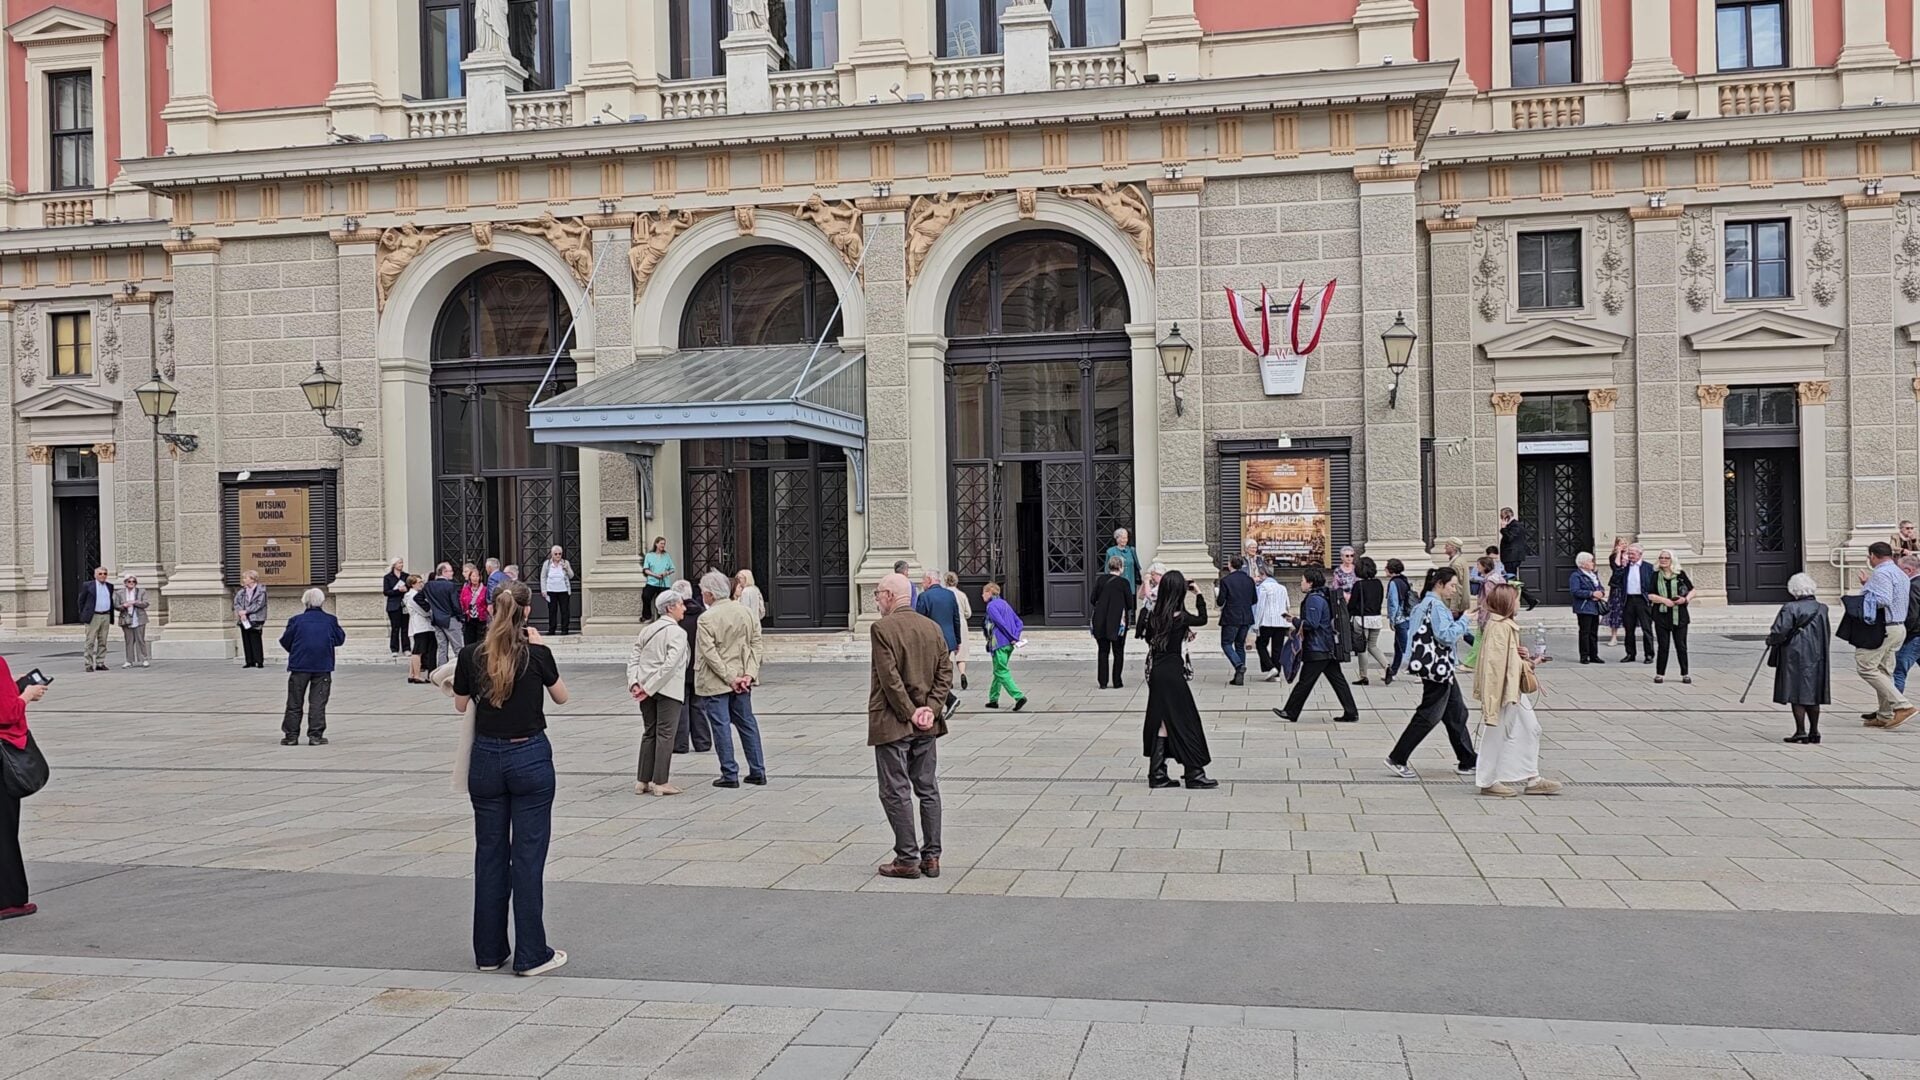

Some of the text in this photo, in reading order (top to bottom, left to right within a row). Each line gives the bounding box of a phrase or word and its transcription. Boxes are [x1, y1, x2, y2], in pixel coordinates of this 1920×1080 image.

[256, 501, 286, 510] MITSUKO
[1267, 493, 1303, 513] ABO
[258, 511, 284, 520] UCHIDA
[258, 560, 287, 568] RICCARDO
